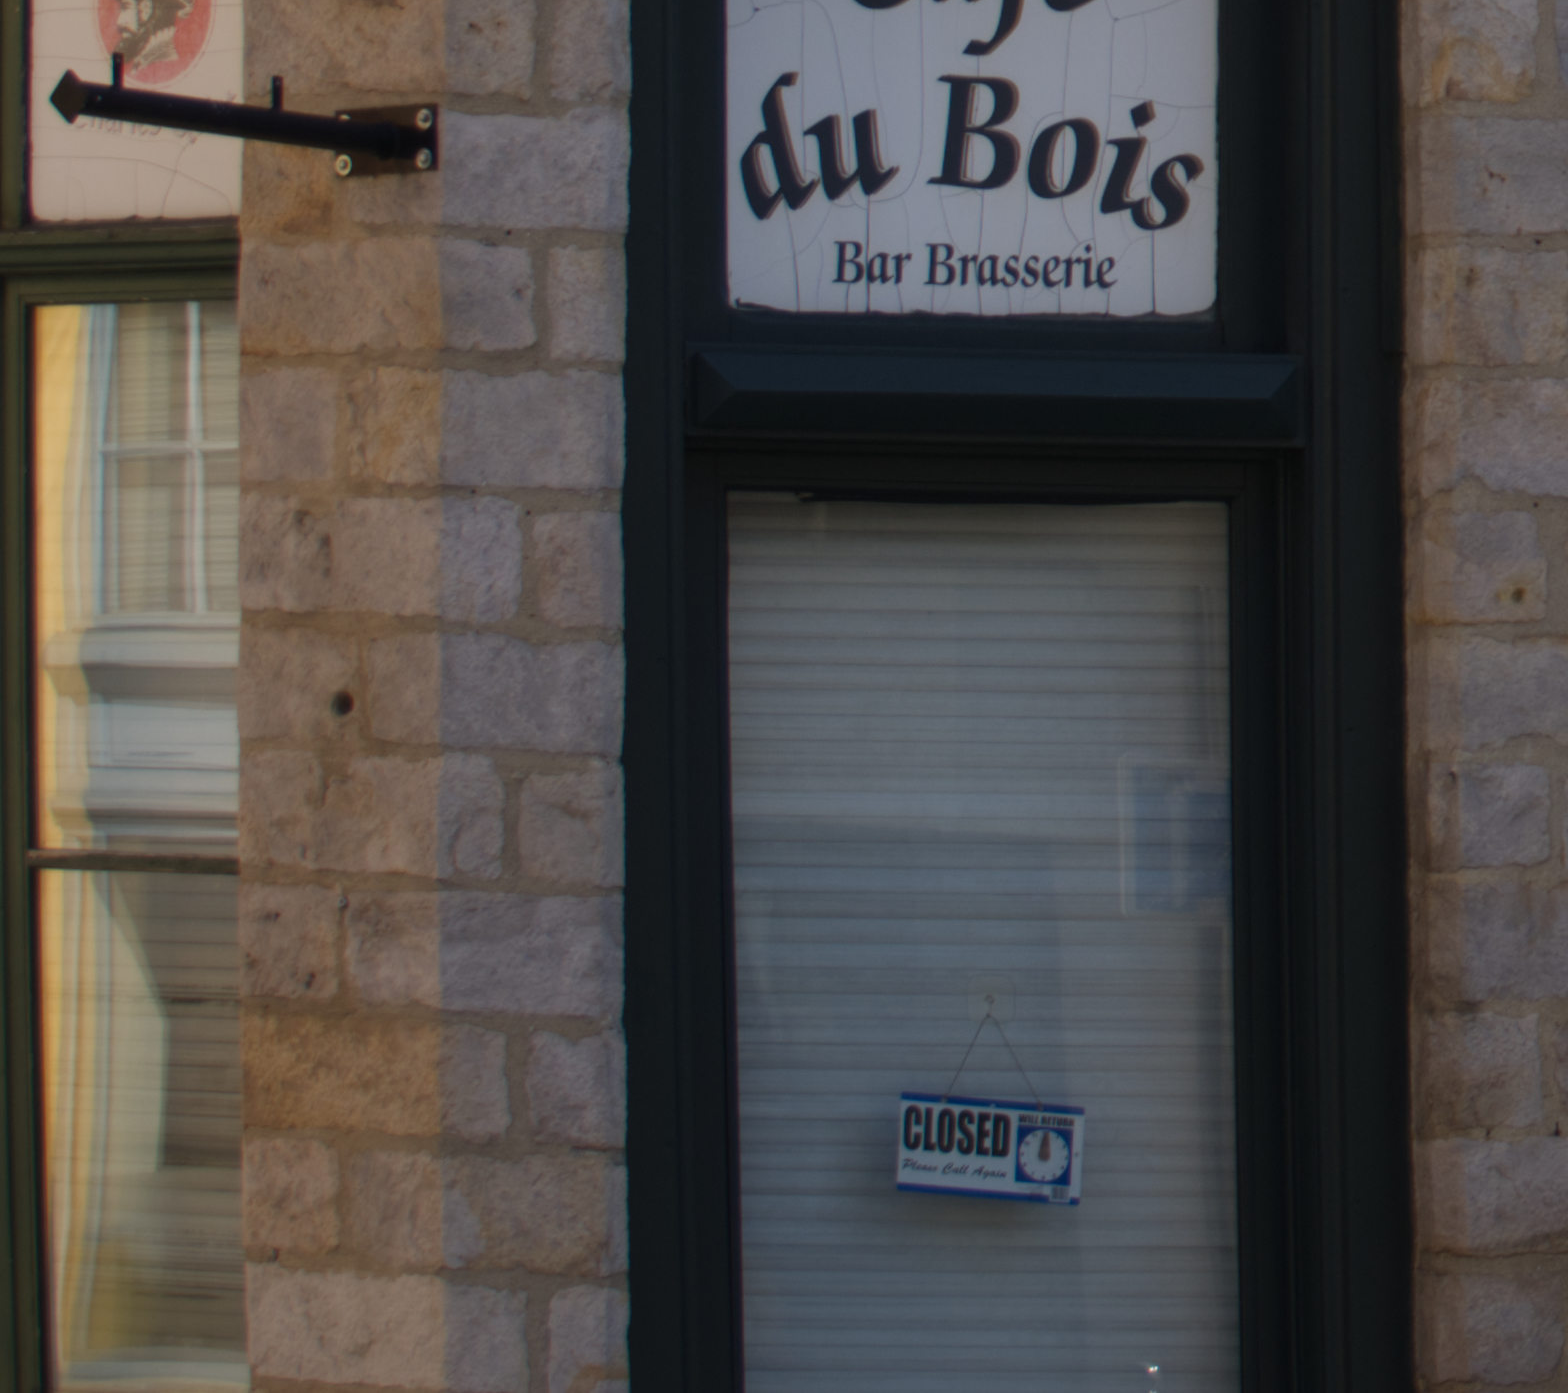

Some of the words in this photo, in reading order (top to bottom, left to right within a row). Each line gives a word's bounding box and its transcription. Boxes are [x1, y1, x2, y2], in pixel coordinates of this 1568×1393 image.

[738, 70, 900, 222] du
[926, 72, 1205, 232] Bois
[832, 239, 912, 286] Bar
[924, 241, 1118, 290] Brasserie
[903, 1104, 1012, 1158] CLOSED
[902, 1158, 939, 1172] Please
[941, 1162, 970, 1175] Call
[970, 1165, 1008, 1180] Again
